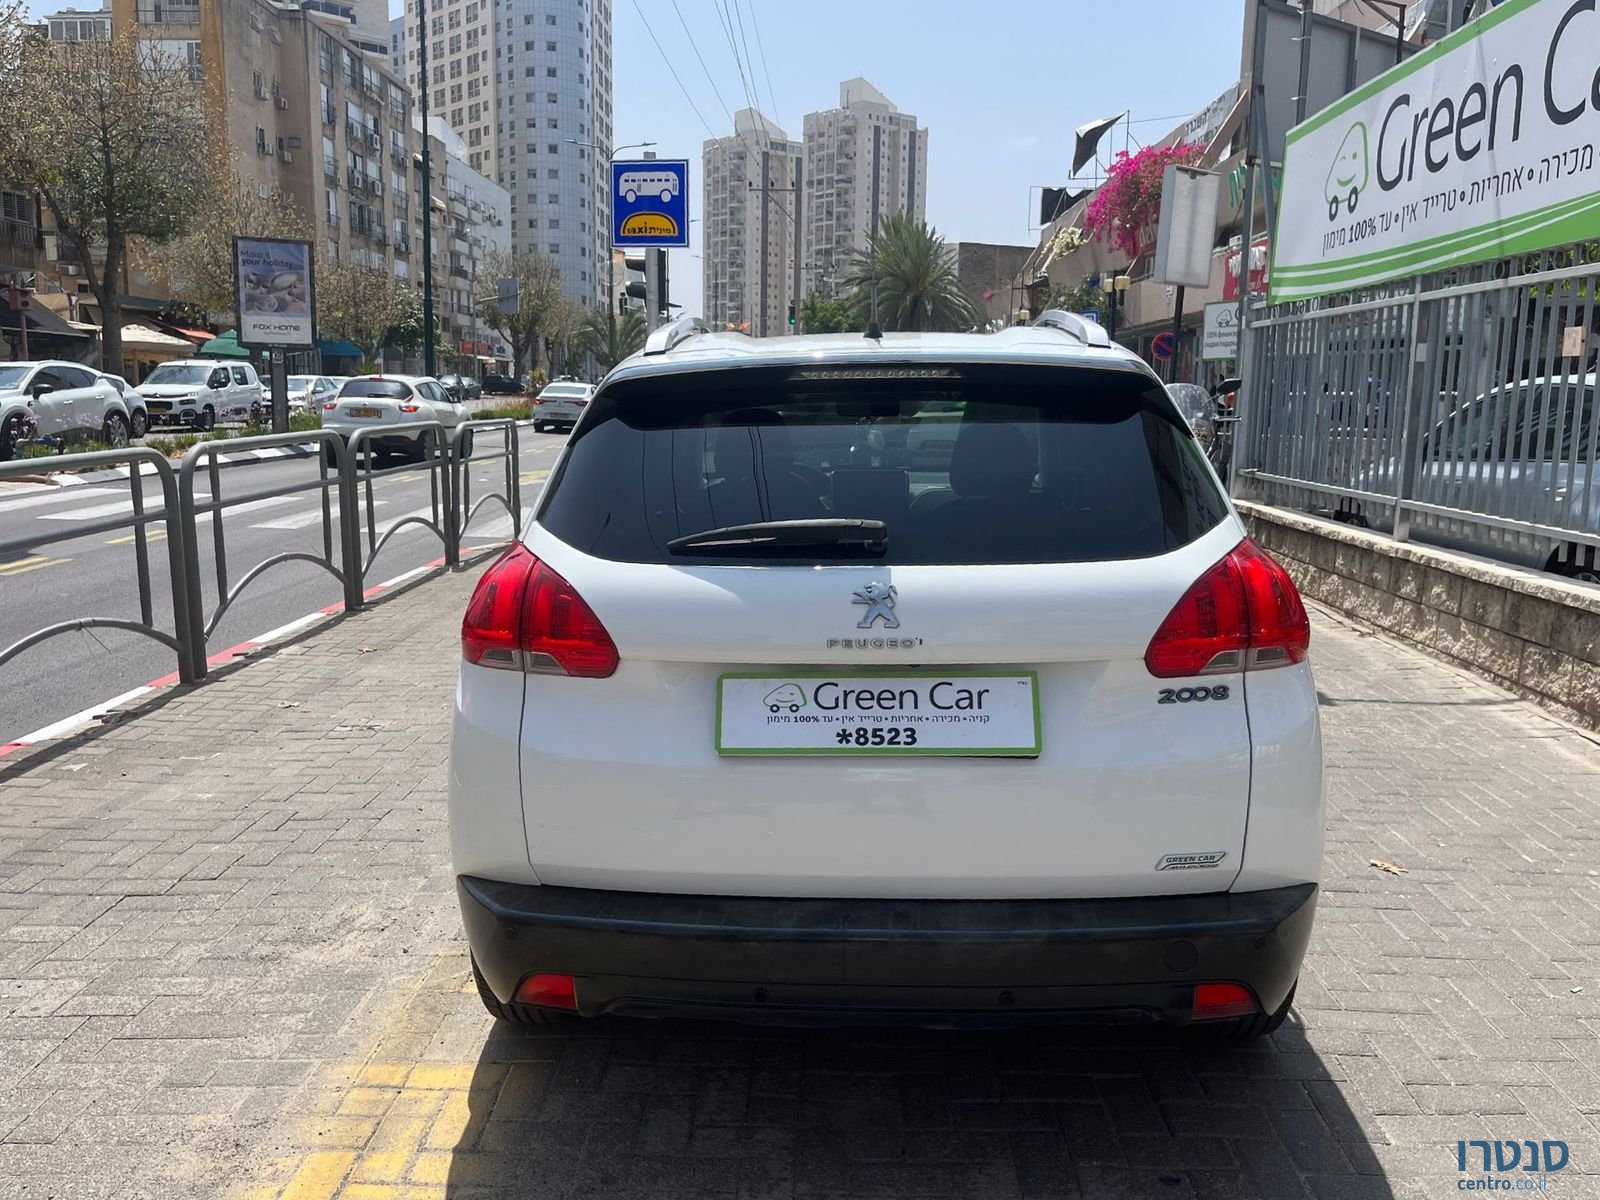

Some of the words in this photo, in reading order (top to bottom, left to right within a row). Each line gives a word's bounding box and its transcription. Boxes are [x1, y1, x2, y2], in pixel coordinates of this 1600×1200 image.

[1376, 63, 1524, 192] Green
[1543, 0, 1600, 125] C
[1538, 143, 1594, 184] מכירה
[1468, 166, 1524, 205] אחריות
[1422, 188, 1457, 218] טרייד
[1379, 210, 1392, 232] עד
[1401, 201, 1418, 232] אין
[627, 221, 648, 234] taxi
[649, 226, 671, 234] מונית
[1348, 216, 1376, 243] 100%
[1322, 227, 1346, 258] מימון
[240, 250, 263, 258] Make
[241, 258, 261, 266] your
[262, 258, 293, 270] holiday
[813, 681, 919, 711] Green
[928, 681, 990, 711] Car
[1158, 684, 1230, 705] 2008
[767, 715, 791, 725] מימון
[793, 715, 820, 723] 100%
[821, 715, 833, 723] עד
[841, 715, 855, 725] אין
[857, 715, 883, 723] טרייד
[890, 714, 924, 723] אחריות
[931, 715, 961, 723] מכירה
[968, 714, 990, 725] קניה
[1166, 856, 1196, 864] GREEN
